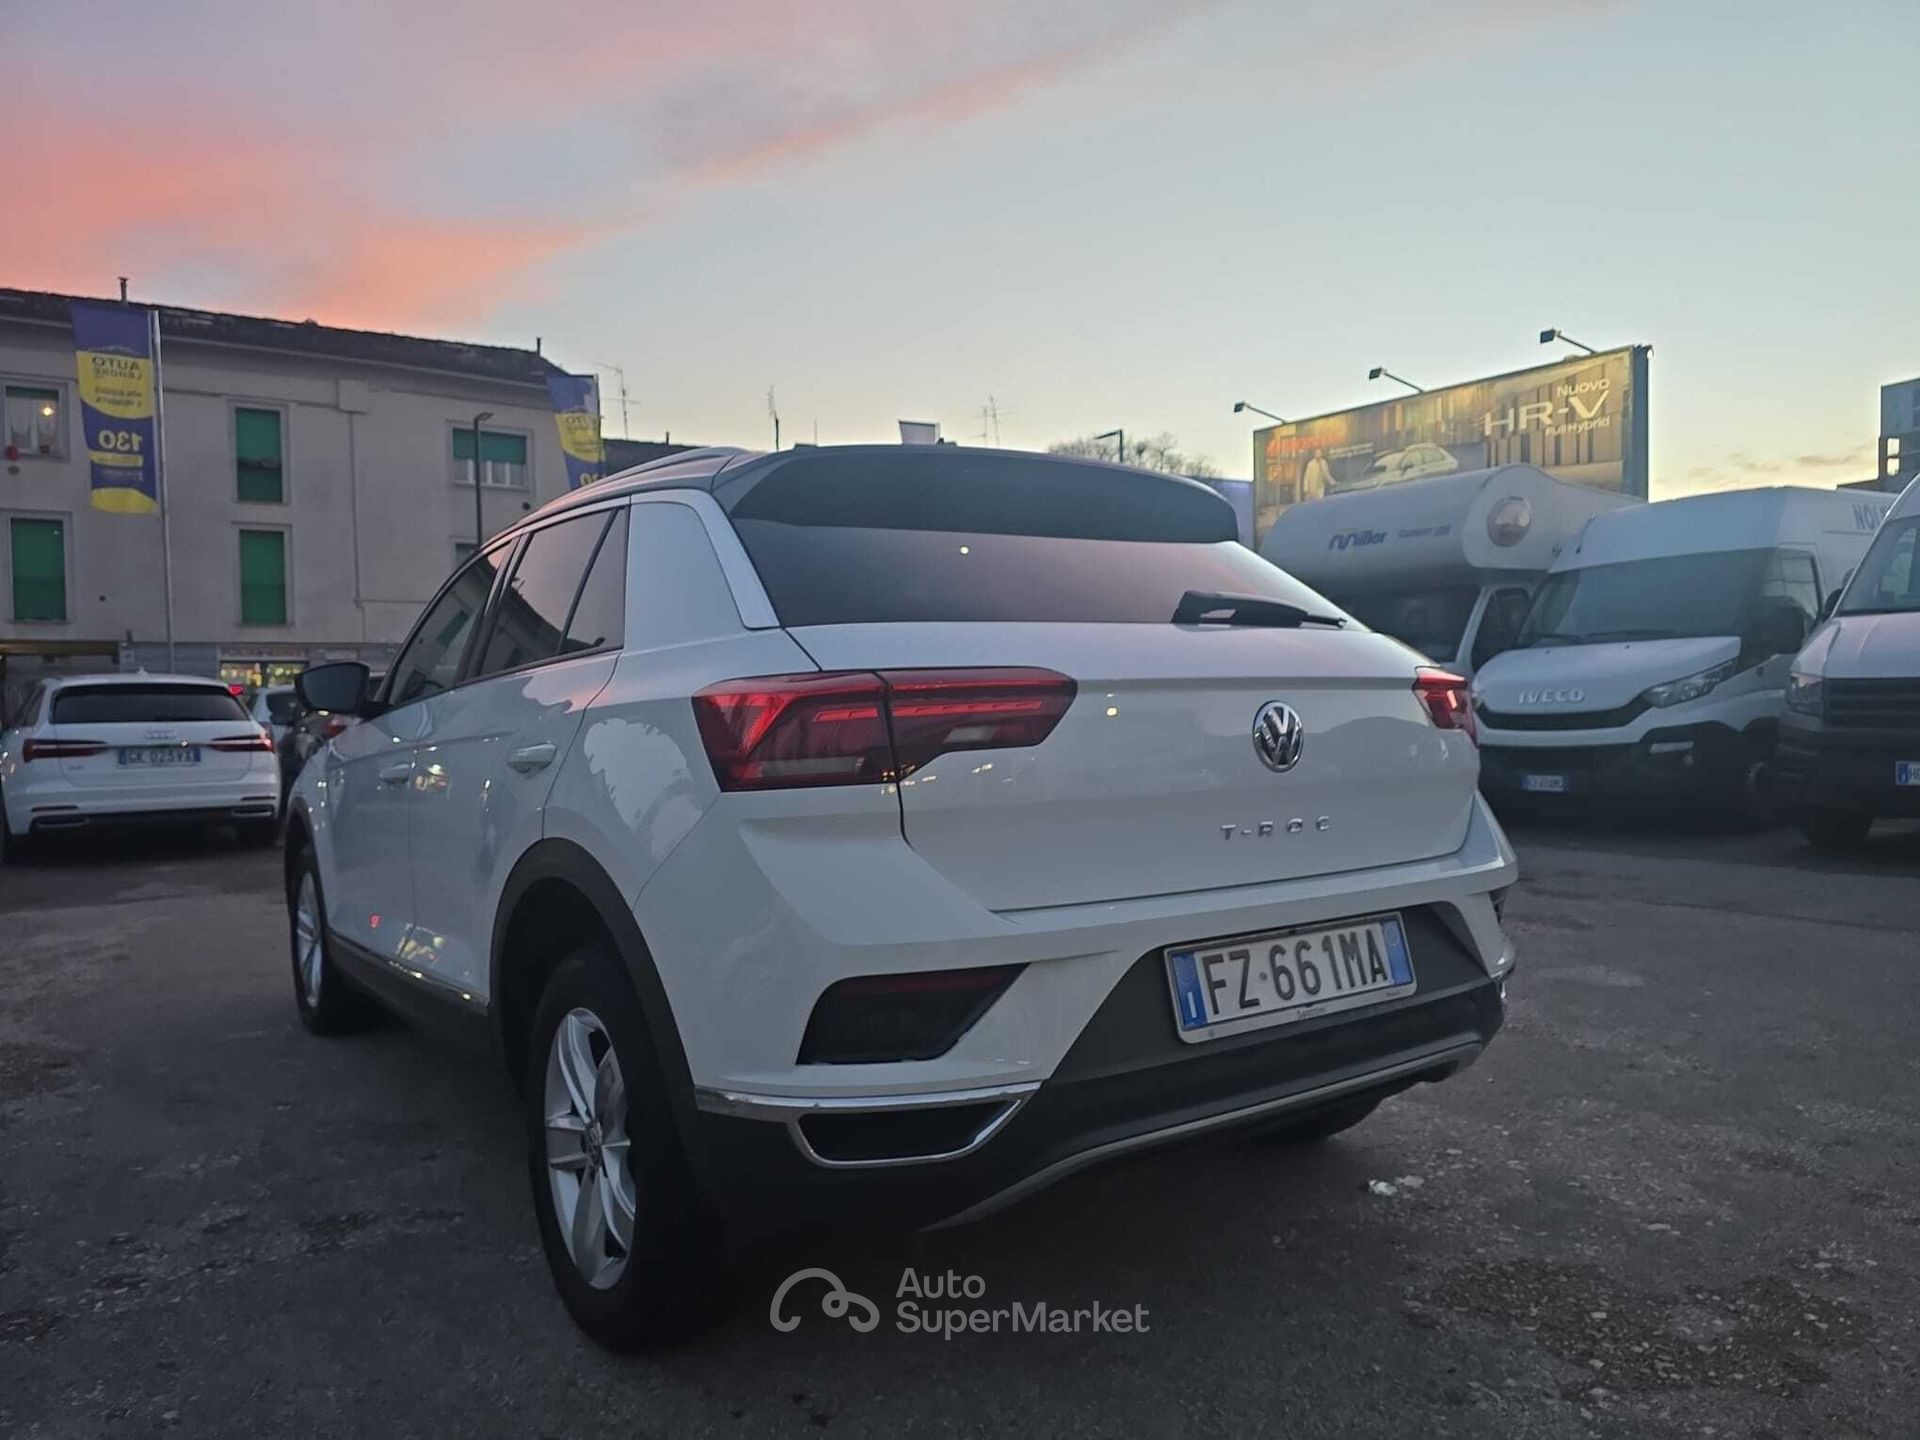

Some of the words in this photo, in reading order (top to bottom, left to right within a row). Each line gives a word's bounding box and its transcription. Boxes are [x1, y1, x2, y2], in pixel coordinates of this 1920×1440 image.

[1556, 379, 1610, 397] Nuovo
[1484, 389, 1610, 436] HR-V
[1519, 688, 1585, 704] IVECO
[1220, 815, 1331, 841] T-ROC
[1201, 949, 1260, 1015] FZ
[1268, 928, 1389, 1001] 661MA
